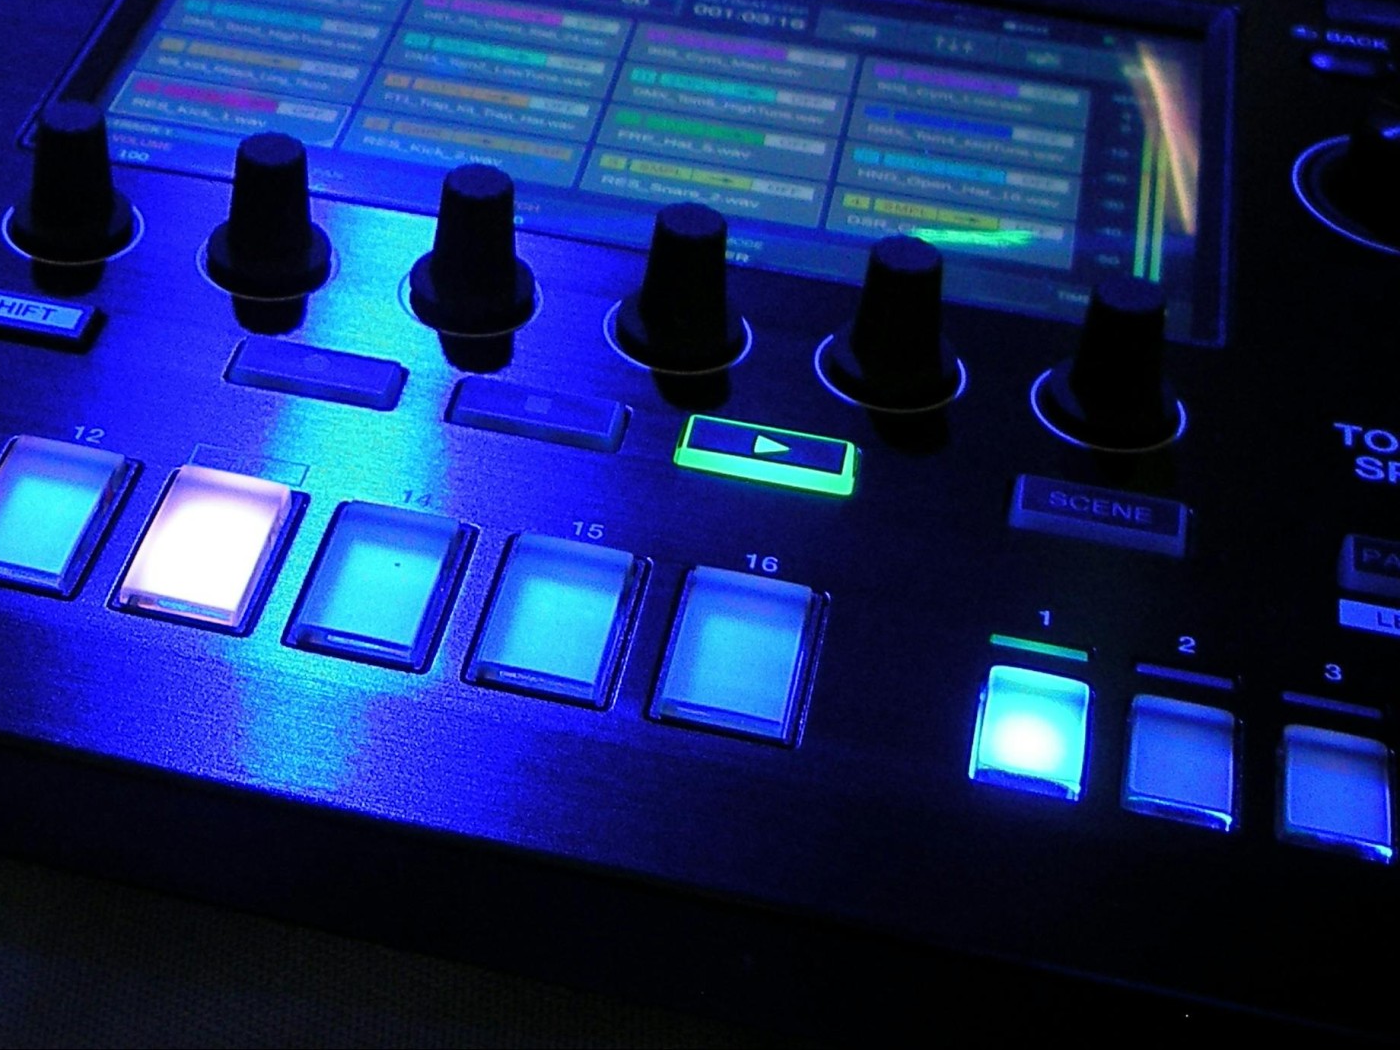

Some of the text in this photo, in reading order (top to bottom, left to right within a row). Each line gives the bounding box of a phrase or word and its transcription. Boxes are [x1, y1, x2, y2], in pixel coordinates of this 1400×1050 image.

[73, 424, 107, 445] 12
[1049, 490, 1153, 524] SCENE
[571, 520, 605, 540] 15
[744, 552, 780, 574] 16
[1038, 610, 1051, 627] 1
[1177, 635, 1197, 654] 2
[1324, 663, 1343, 681] 3
